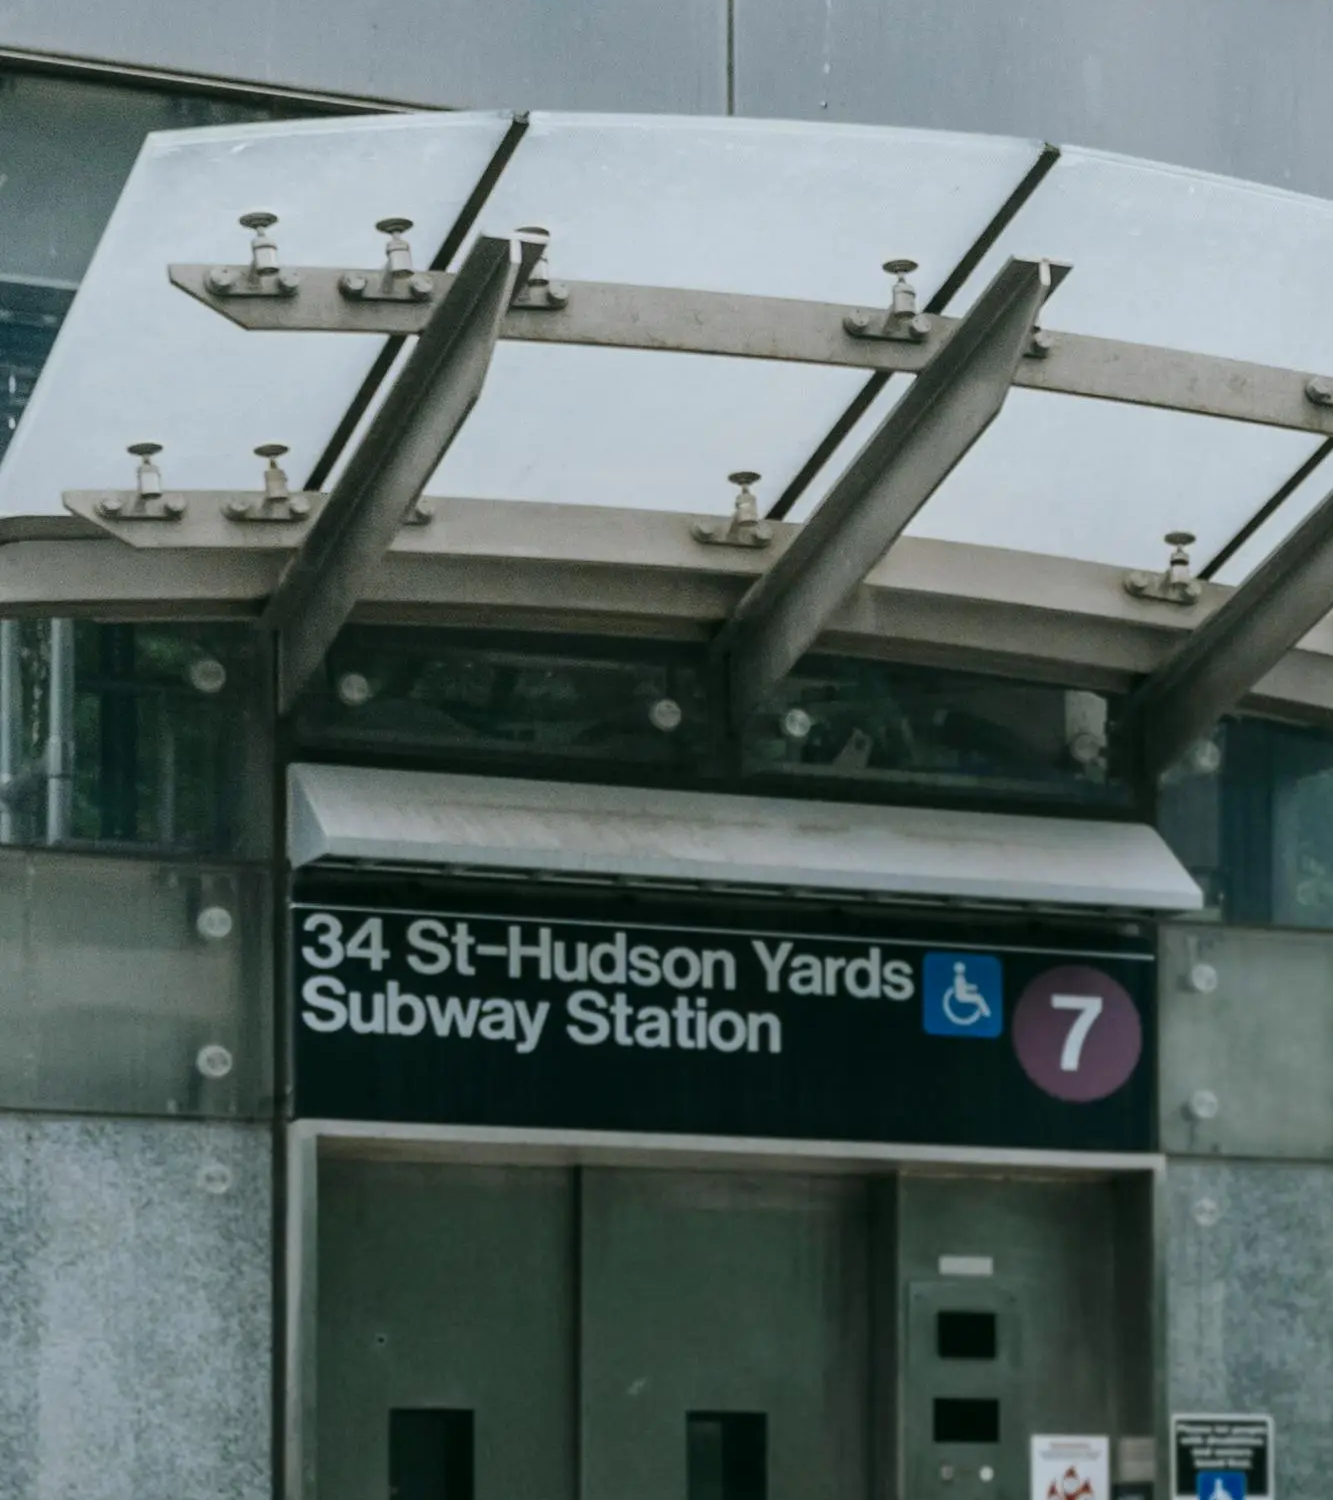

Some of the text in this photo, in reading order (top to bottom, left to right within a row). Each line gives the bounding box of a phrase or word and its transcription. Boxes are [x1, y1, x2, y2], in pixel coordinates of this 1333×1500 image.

[301, 913, 391, 971] 34
[752, 940, 915, 1001] Yards
[301, 975, 782, 1054] Subway Station
[1049, 994, 1103, 1072] 7
